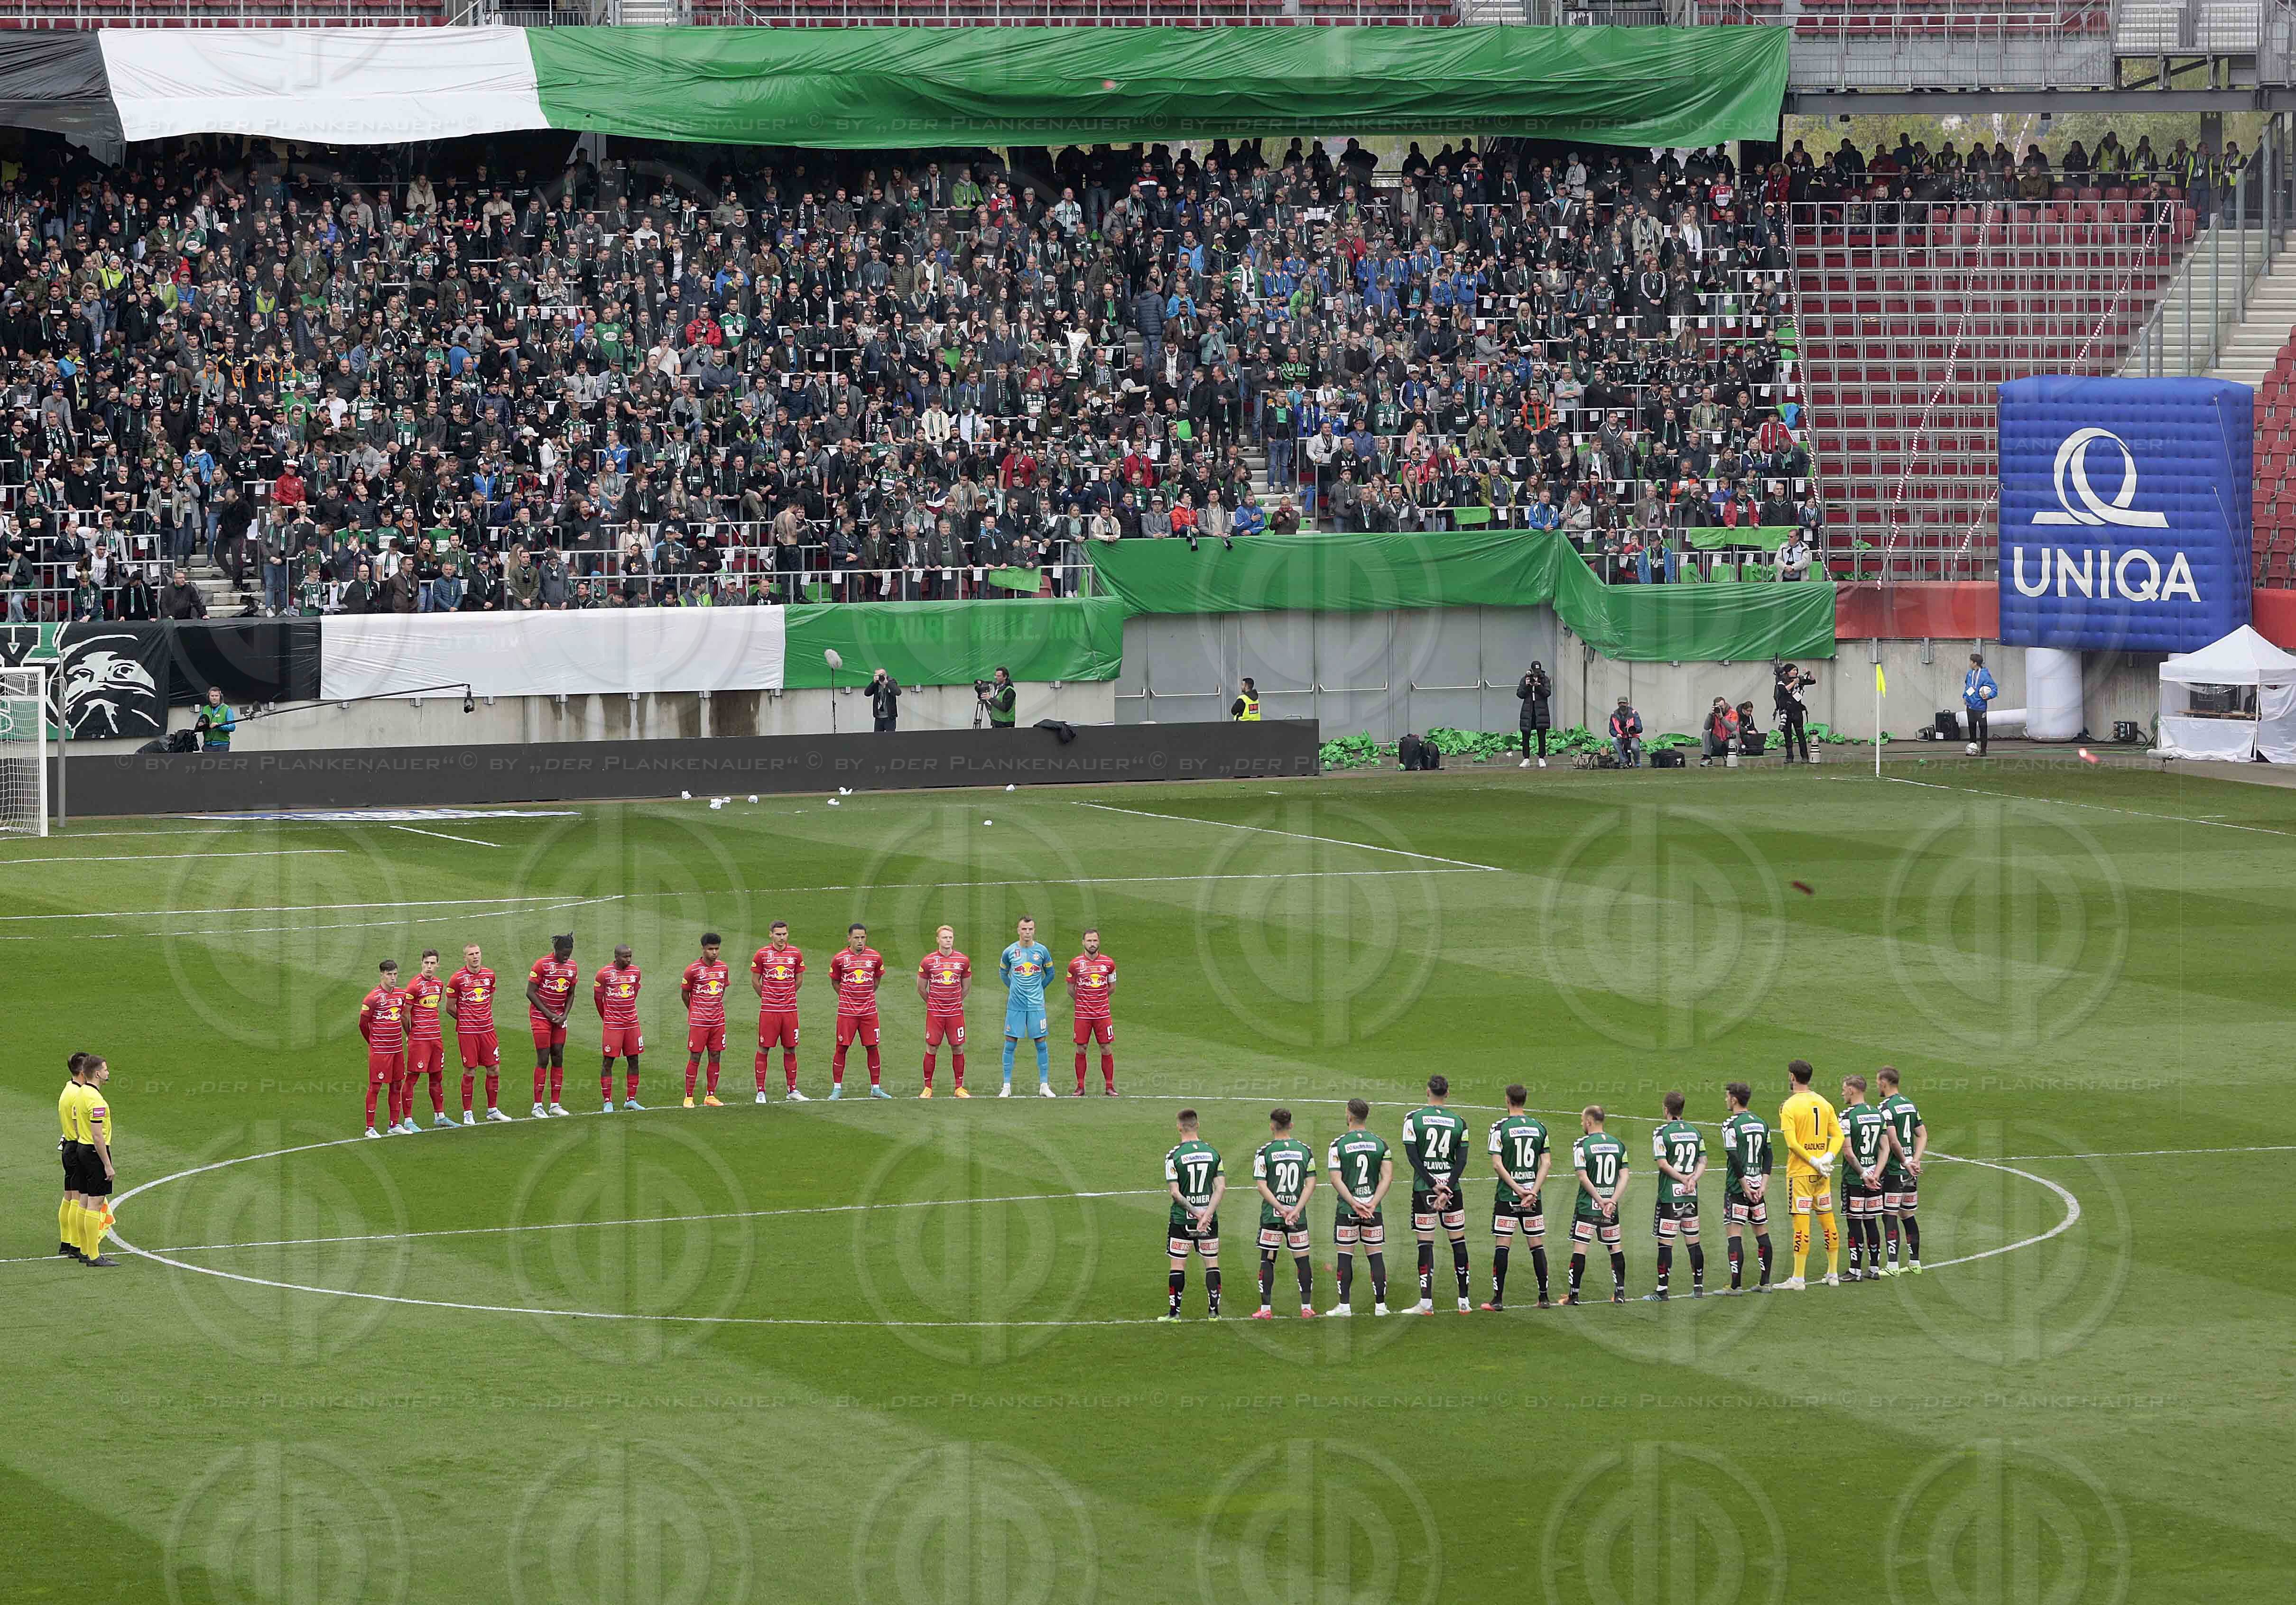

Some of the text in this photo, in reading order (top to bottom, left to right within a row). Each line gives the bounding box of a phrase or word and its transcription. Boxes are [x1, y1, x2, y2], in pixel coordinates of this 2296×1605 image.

[2014, 547, 2201, 602] UNIQA
[1813, 1107, 1819, 1136] 1
[1903, 1115, 1911, 1144] 4
[1425, 1127, 1451, 1158] 24
[1515, 1138, 1535, 1168] 16
[1860, 1125, 1880, 1154] 37
[1356, 1154, 1368, 1185] 2
[1596, 1153, 1616, 1185] 10
[1674, 1143, 1696, 1172] 22
[1187, 1163, 1208, 1193] 17
[1276, 1162, 1299, 1193] 20
